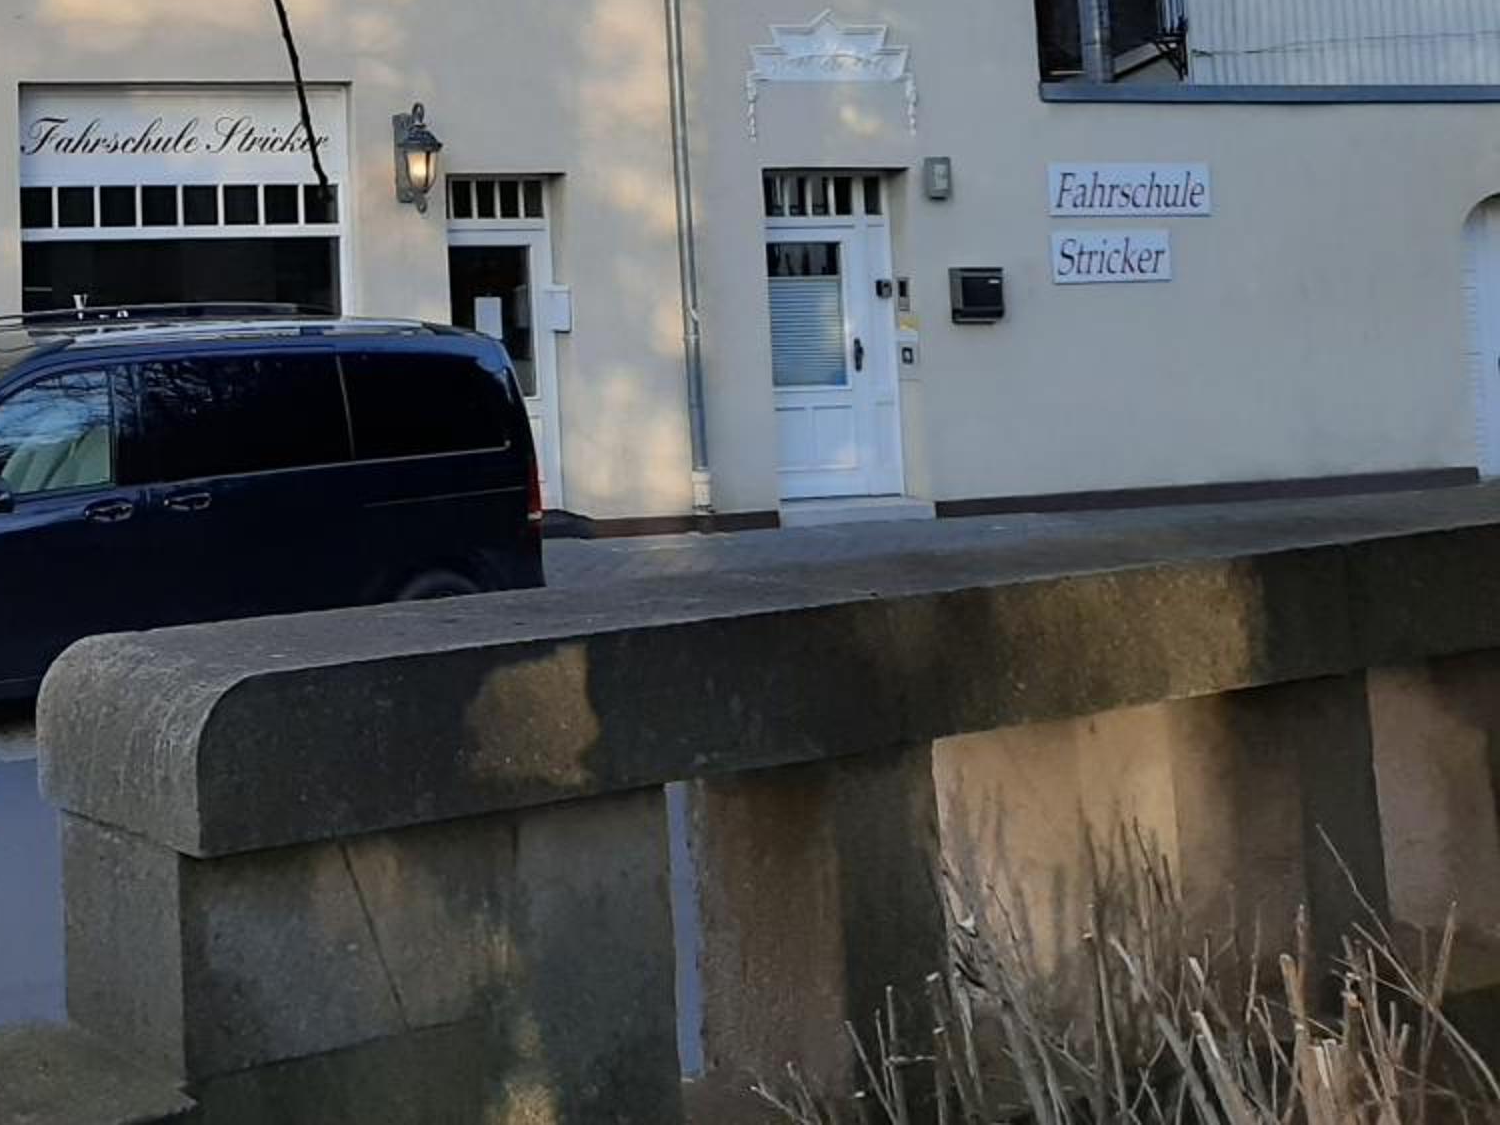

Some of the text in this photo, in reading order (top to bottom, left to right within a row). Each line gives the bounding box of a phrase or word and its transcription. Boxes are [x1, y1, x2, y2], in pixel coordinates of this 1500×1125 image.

[20, 116, 330, 156] Fahrschule Stricker
[1055, 170, 1205, 209] Fahrschule
[1057, 236, 1166, 276] Stricker
